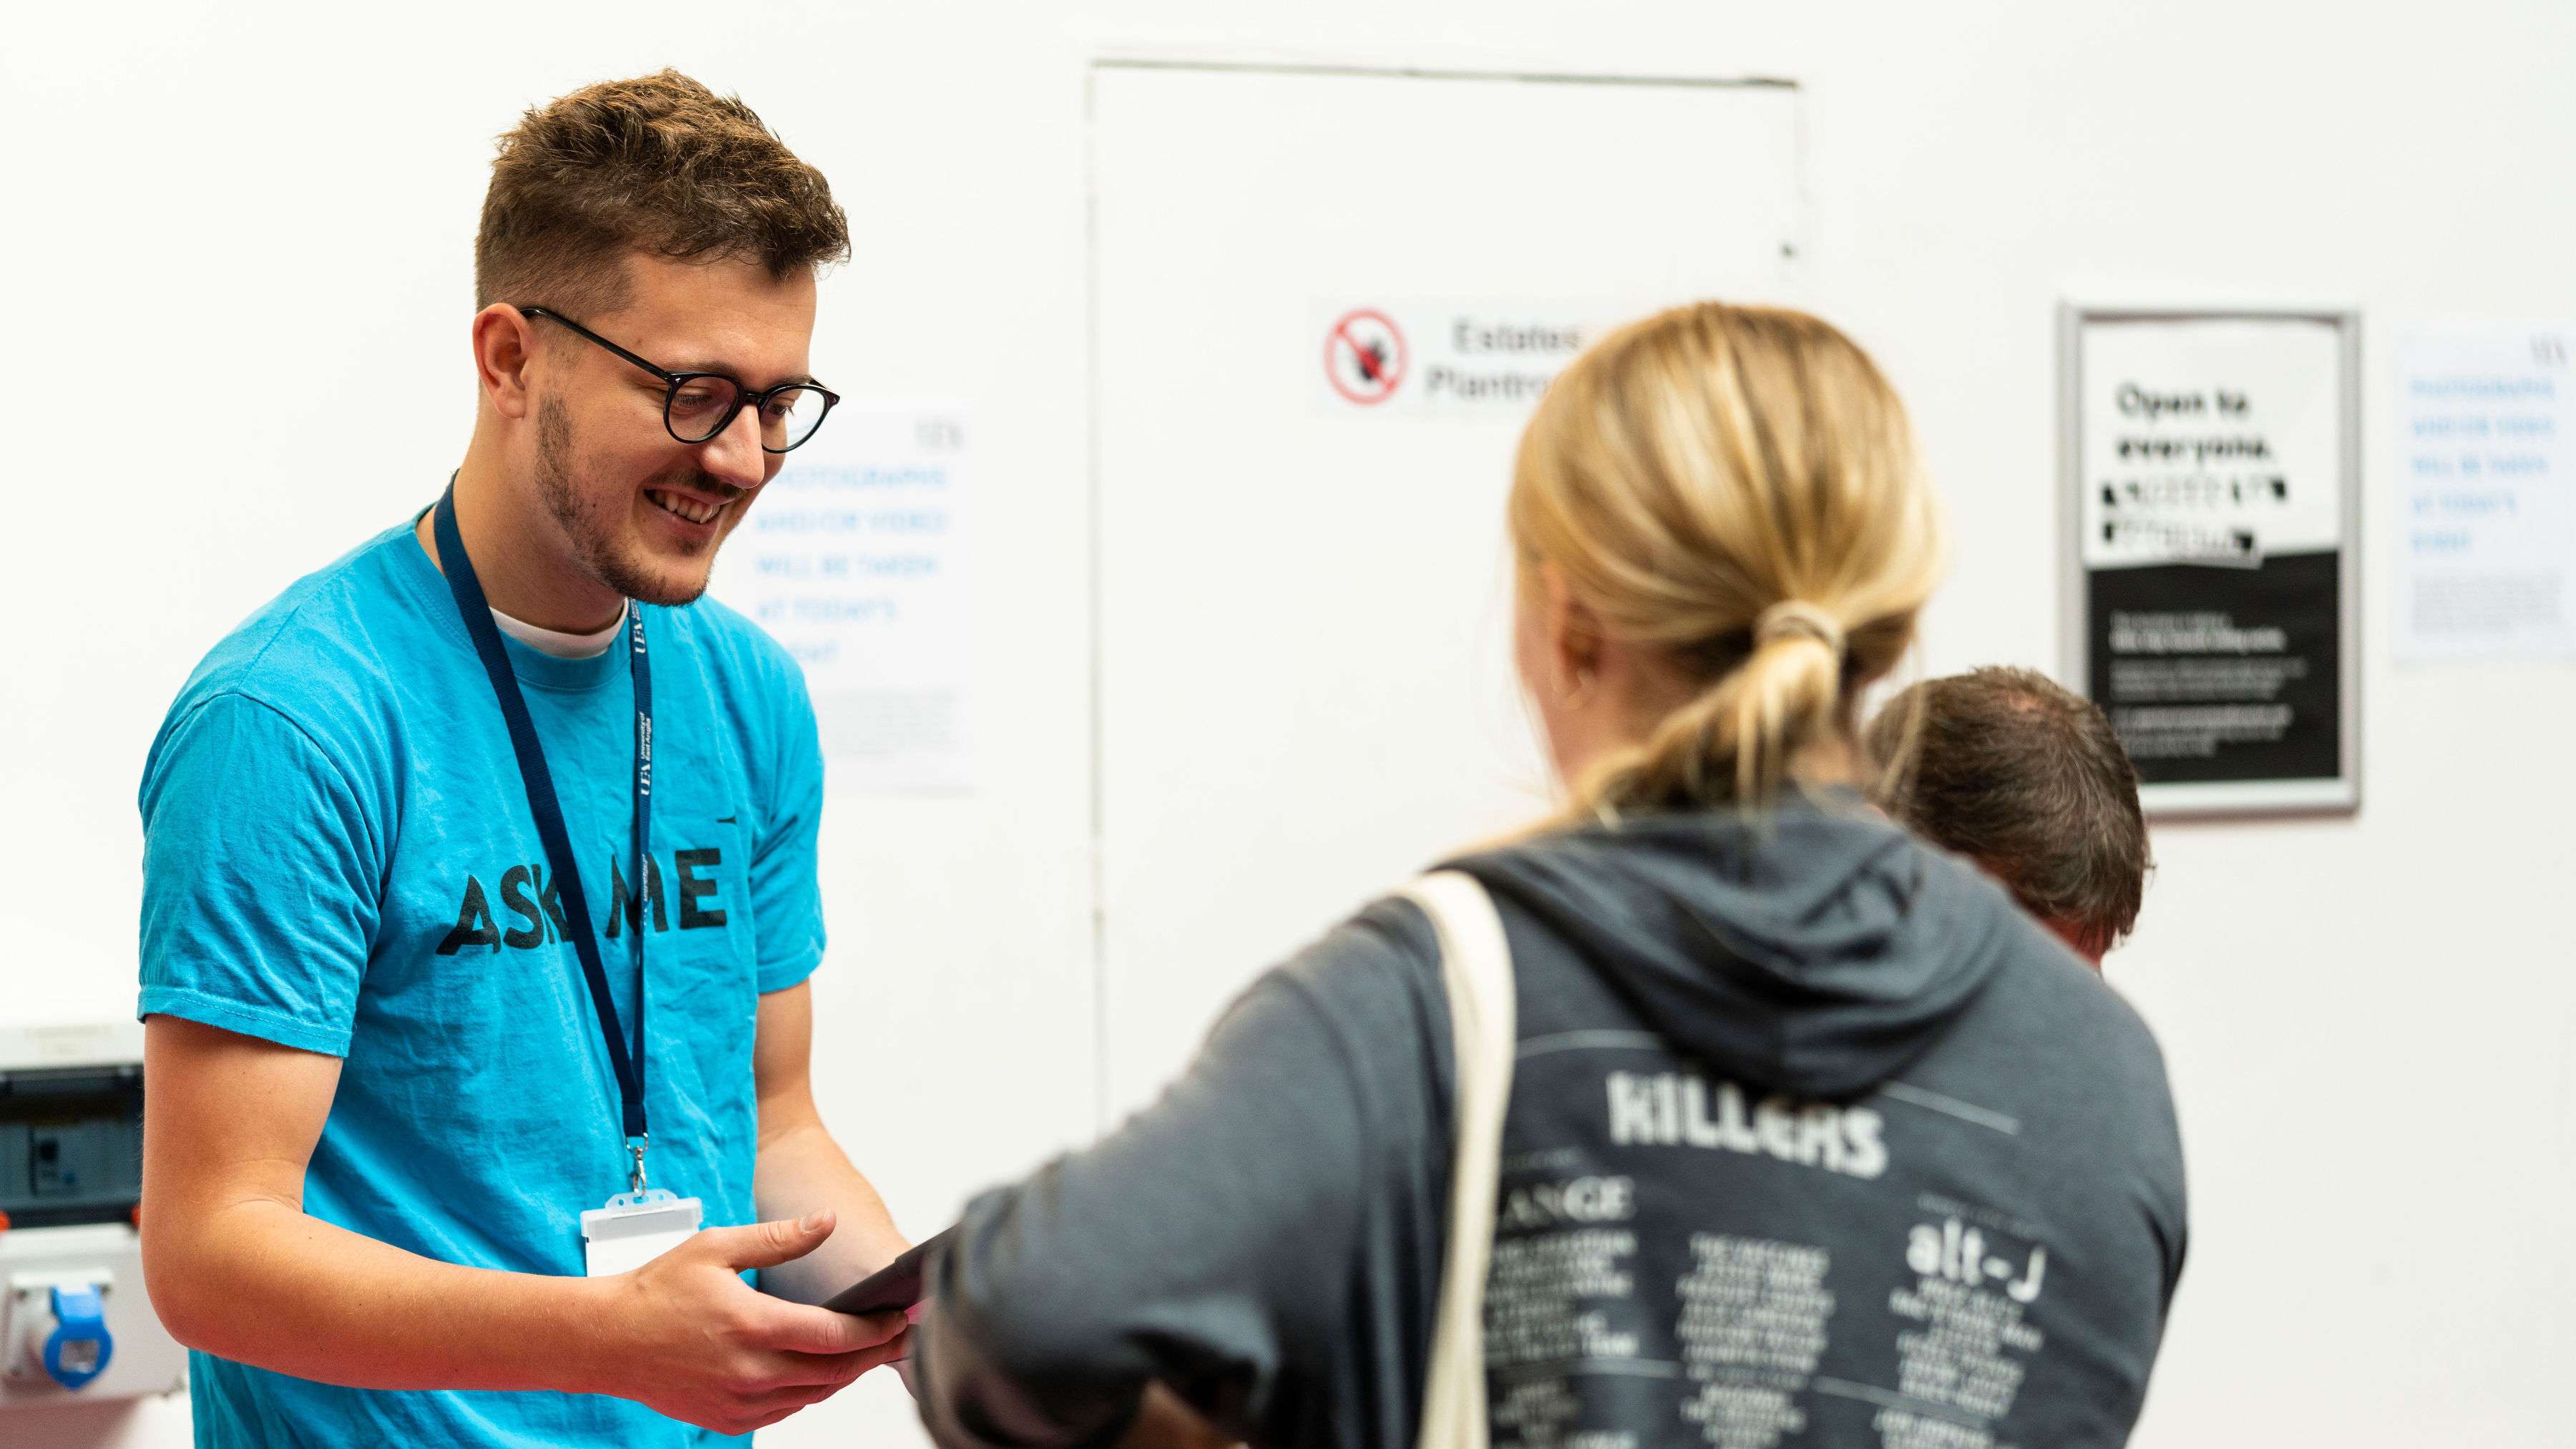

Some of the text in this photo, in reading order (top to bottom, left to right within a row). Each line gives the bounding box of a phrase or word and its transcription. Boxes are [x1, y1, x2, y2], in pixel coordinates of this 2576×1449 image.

[2117, 384, 2203, 419] Open
[435, 863, 575, 956] ASK
[605, 847, 728, 939] ME
